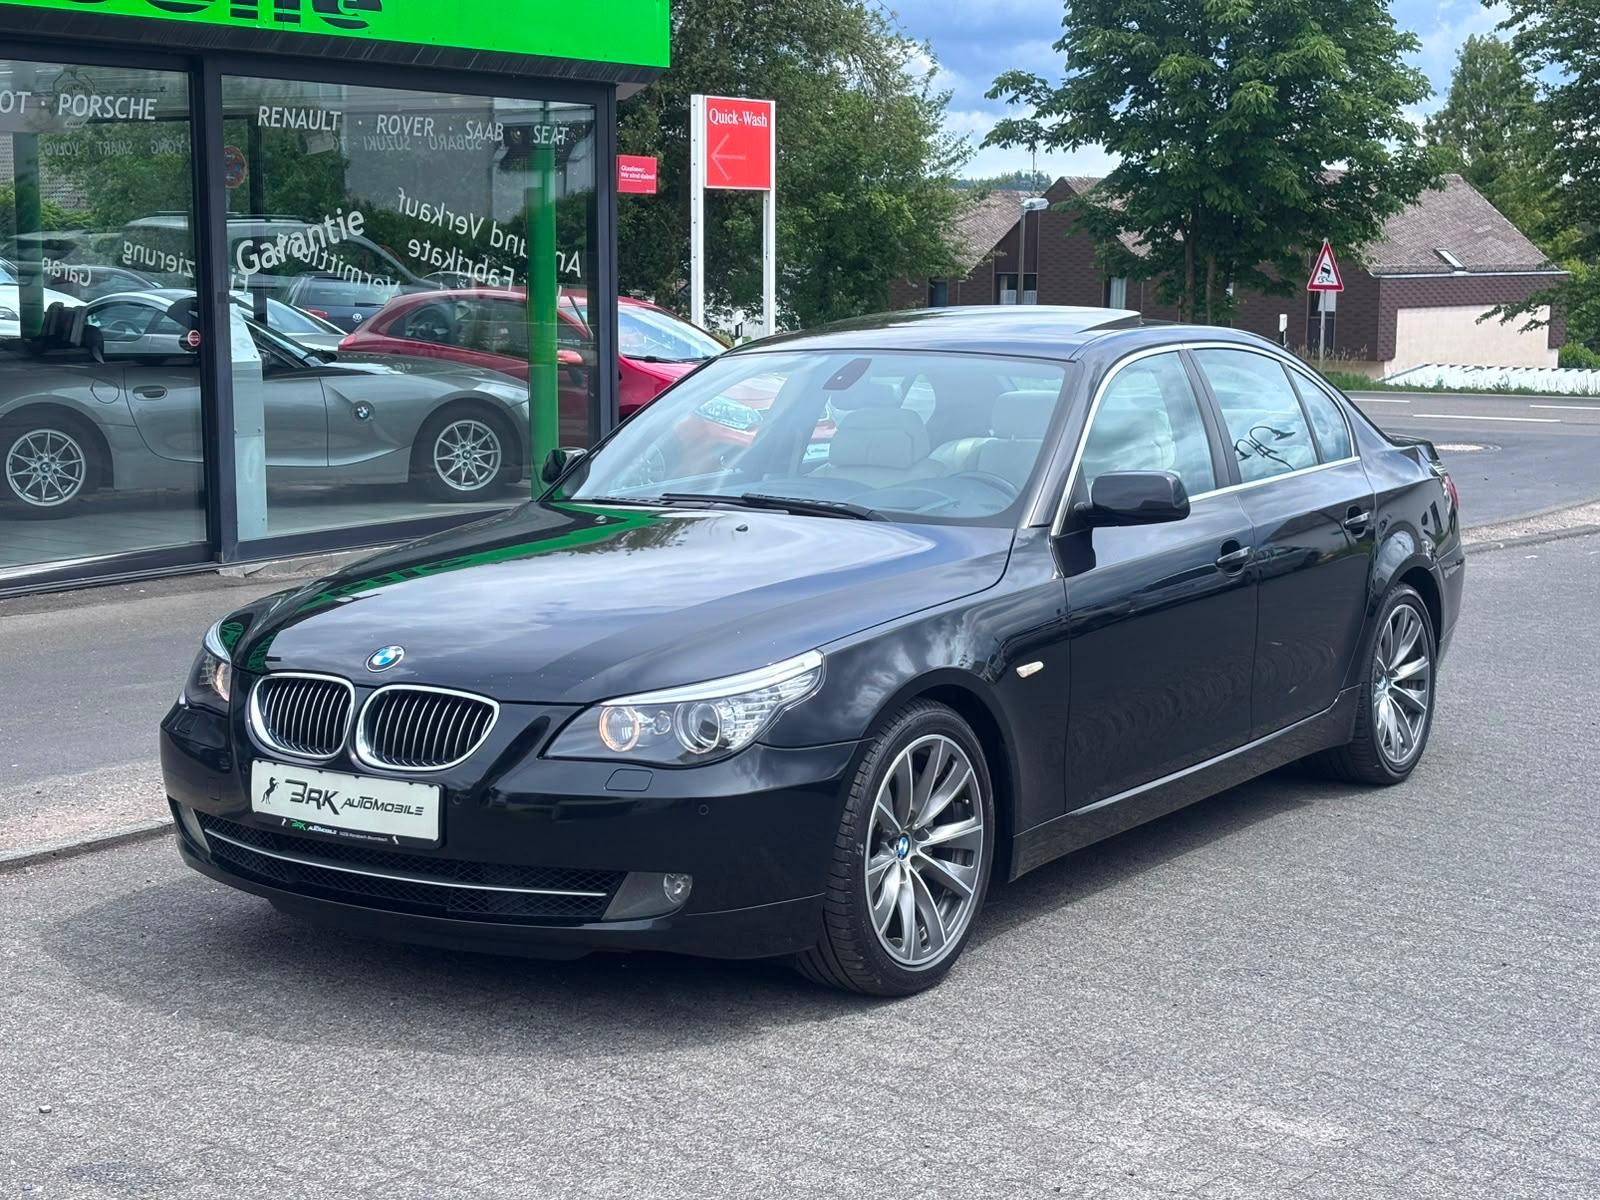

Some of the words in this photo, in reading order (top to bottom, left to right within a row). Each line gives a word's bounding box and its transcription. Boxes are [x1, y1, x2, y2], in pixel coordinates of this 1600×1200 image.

[58, 93, 158, 120] PORSCHE
[709, 108, 768, 128] Quick-Wash
[257, 106, 342, 131] RENAULT
[376, 114, 435, 137] ROVER
[465, 120, 505, 141] SAAB
[532, 126, 570, 146] SEAT
[236, 207, 365, 275] Garantie
